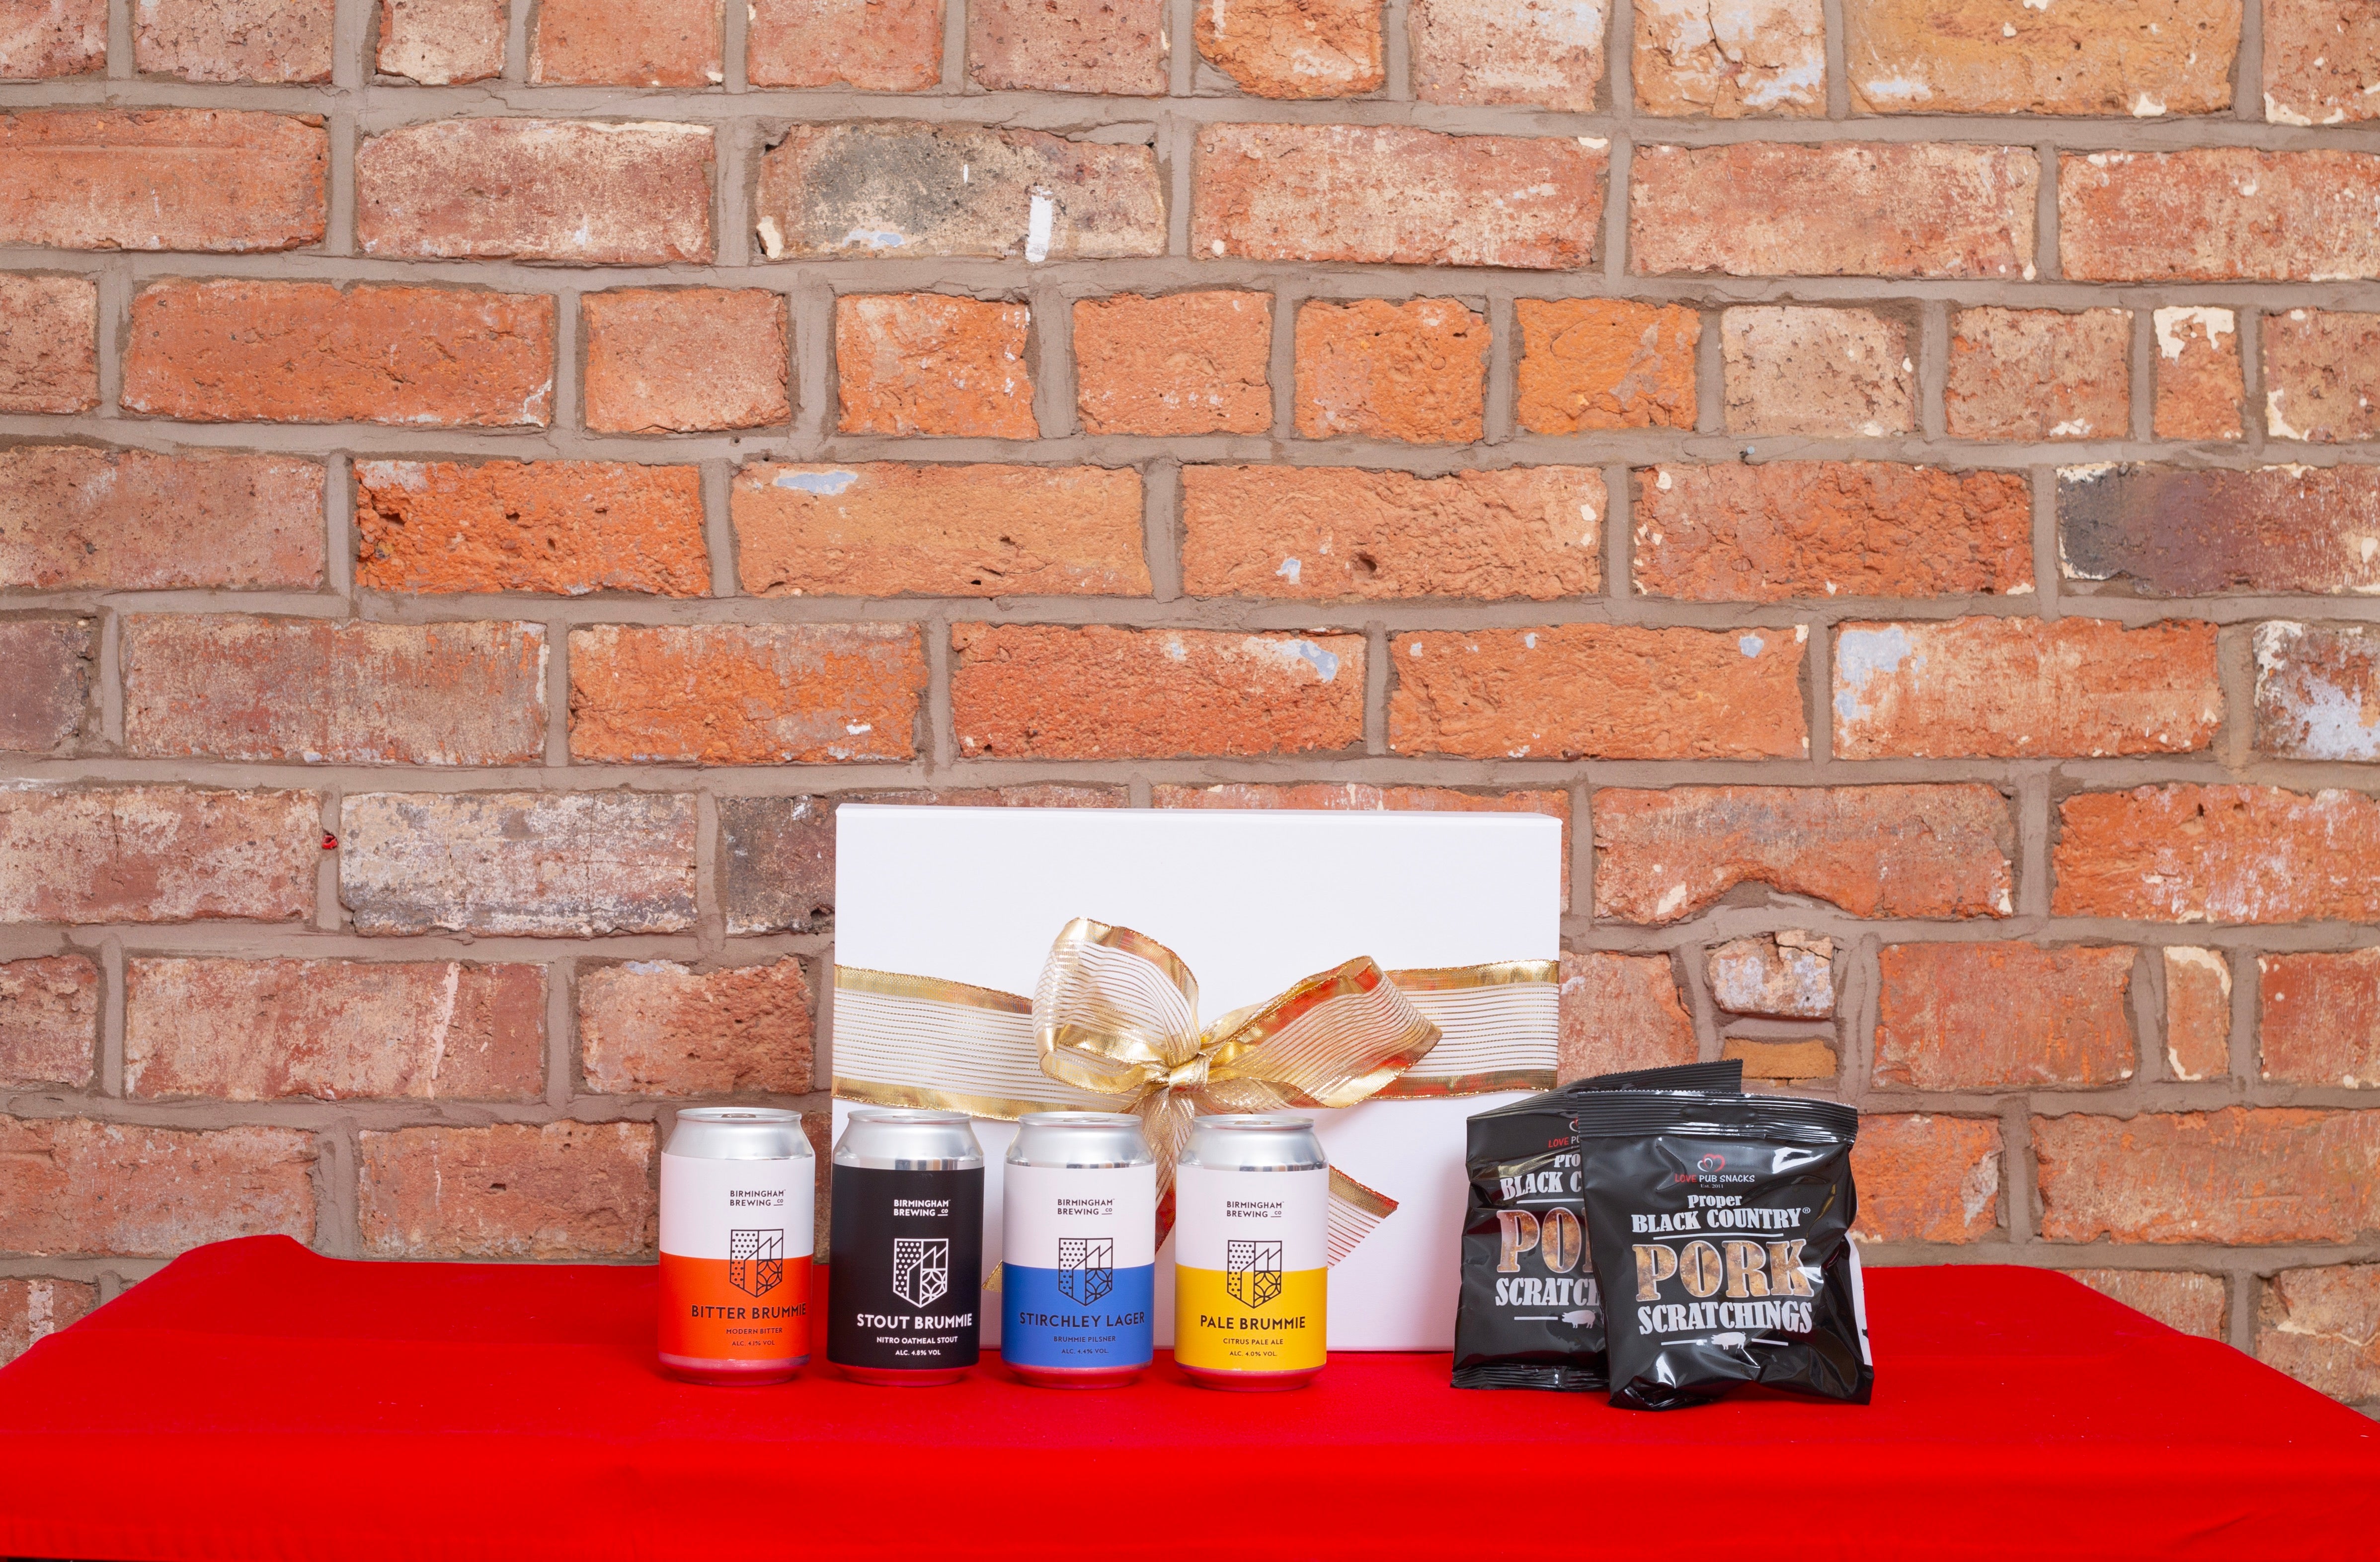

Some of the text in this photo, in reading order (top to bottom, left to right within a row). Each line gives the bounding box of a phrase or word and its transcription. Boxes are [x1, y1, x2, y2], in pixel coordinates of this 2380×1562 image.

[1548, 1137, 1569, 1148] LOVE
[1500, 1171, 1563, 1201] BLACK
[1674, 1173, 1697, 1183] LOVE
[1687, 1194, 1742, 1208] Proper
[1631, 1211, 1701, 1233] BLACK
[1496, 1207, 1593, 1273] PO
[1632, 1239, 1814, 1302] PORK
[692, 1303, 806, 1319] BITTER BRUMMIE
[1637, 1300, 1813, 1335] SCRATCHINGS
[857, 1313, 972, 1329] STOUT BRUMMIE
[1020, 1311, 1145, 1328] STIRCHLEY LAGER
[1200, 1315, 1306, 1330] PALE BRUMMIE
